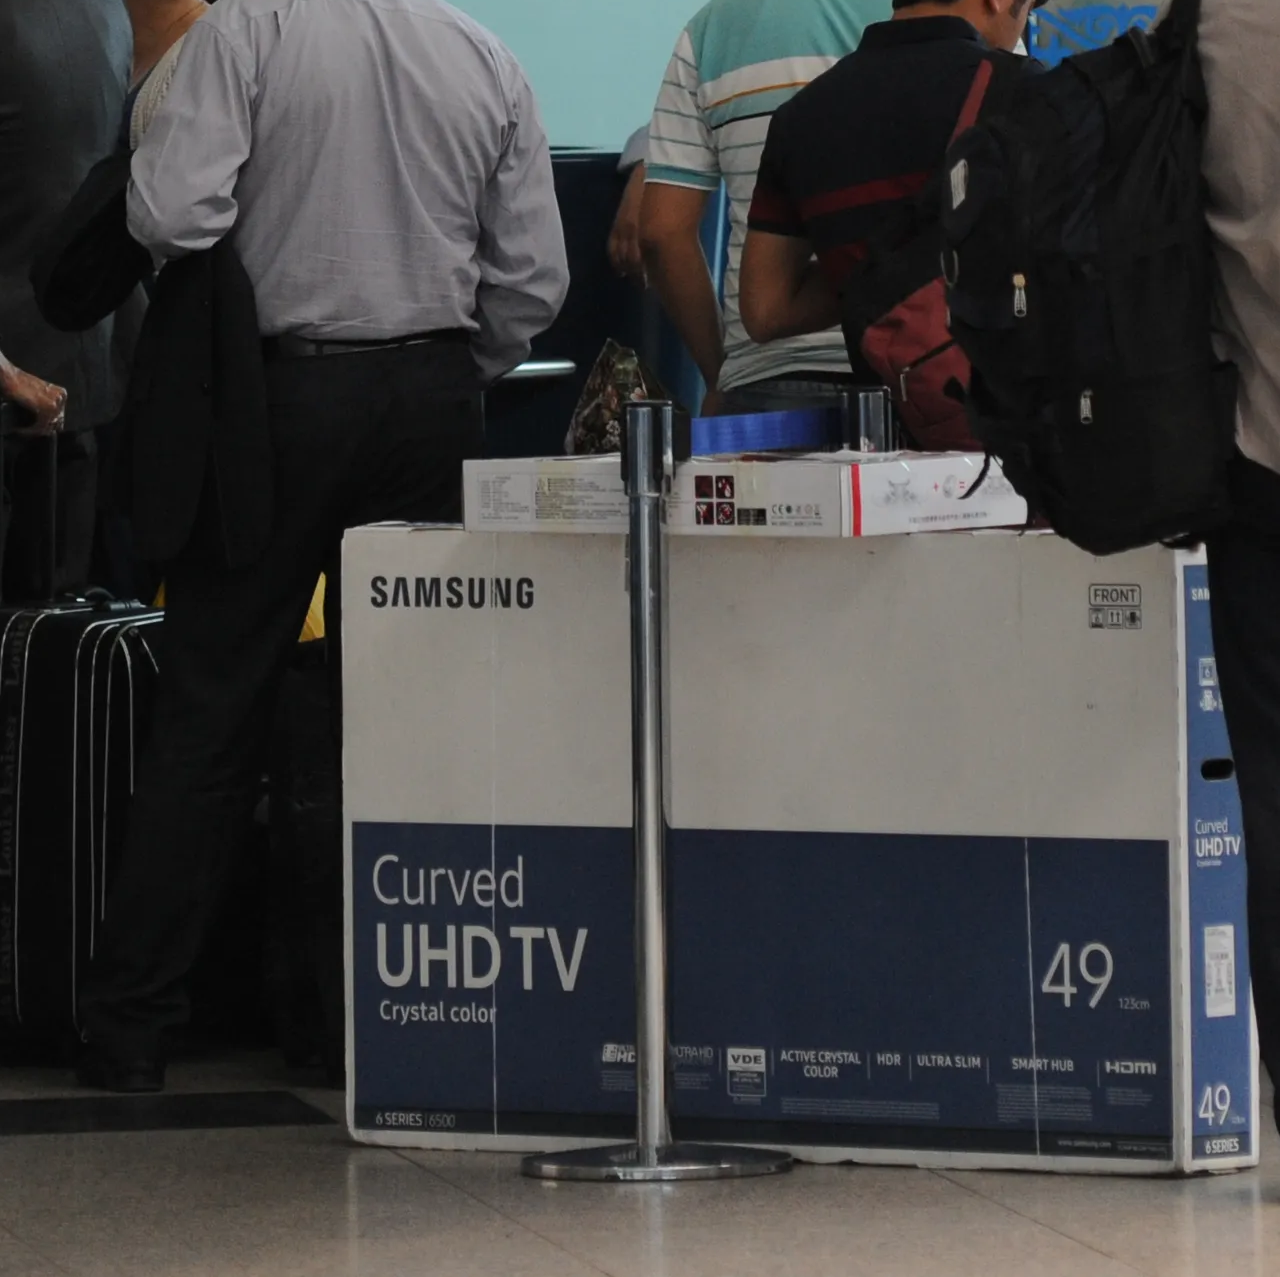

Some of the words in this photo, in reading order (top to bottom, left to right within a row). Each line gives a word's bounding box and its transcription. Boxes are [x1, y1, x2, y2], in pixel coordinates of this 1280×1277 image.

[370, 575, 535, 610] SAMSUNG
[1094, 588, 1137, 603] FRONT
[1195, 818, 1228, 835] Curved
[372, 855, 524, 909] Curved
[376, 923, 502, 989] UHD
[510, 926, 588, 992] TV
[1041, 942, 1114, 1009] 49
[1118, 998, 1150, 1010] 123cm
[379, 1000, 445, 1025] Crystal
[450, 1002, 496, 1024] color
[731, 1054, 763, 1065] VDE
[781, 1050, 816, 1064] ACTIVE
[819, 1051, 861, 1065] CRYSTAL
[877, 1054, 901, 1067] HDR
[917, 1054, 952, 1068] ULTRA
[955, 1056, 981, 1068] SLIM
[1012, 1058, 1049, 1072] SMART
[1051, 1059, 1074, 1072] HUB
[803, 1066, 839, 1079] COLOR
[1198, 1084, 1231, 1126] 49
[376, 1113, 383, 1125] 6
[385, 1112, 422, 1127] SERIES
[428, 1113, 456, 1127] 6500
[1205, 1140, 1211, 1154] 6
[1212, 1138, 1239, 1153] SERIES
